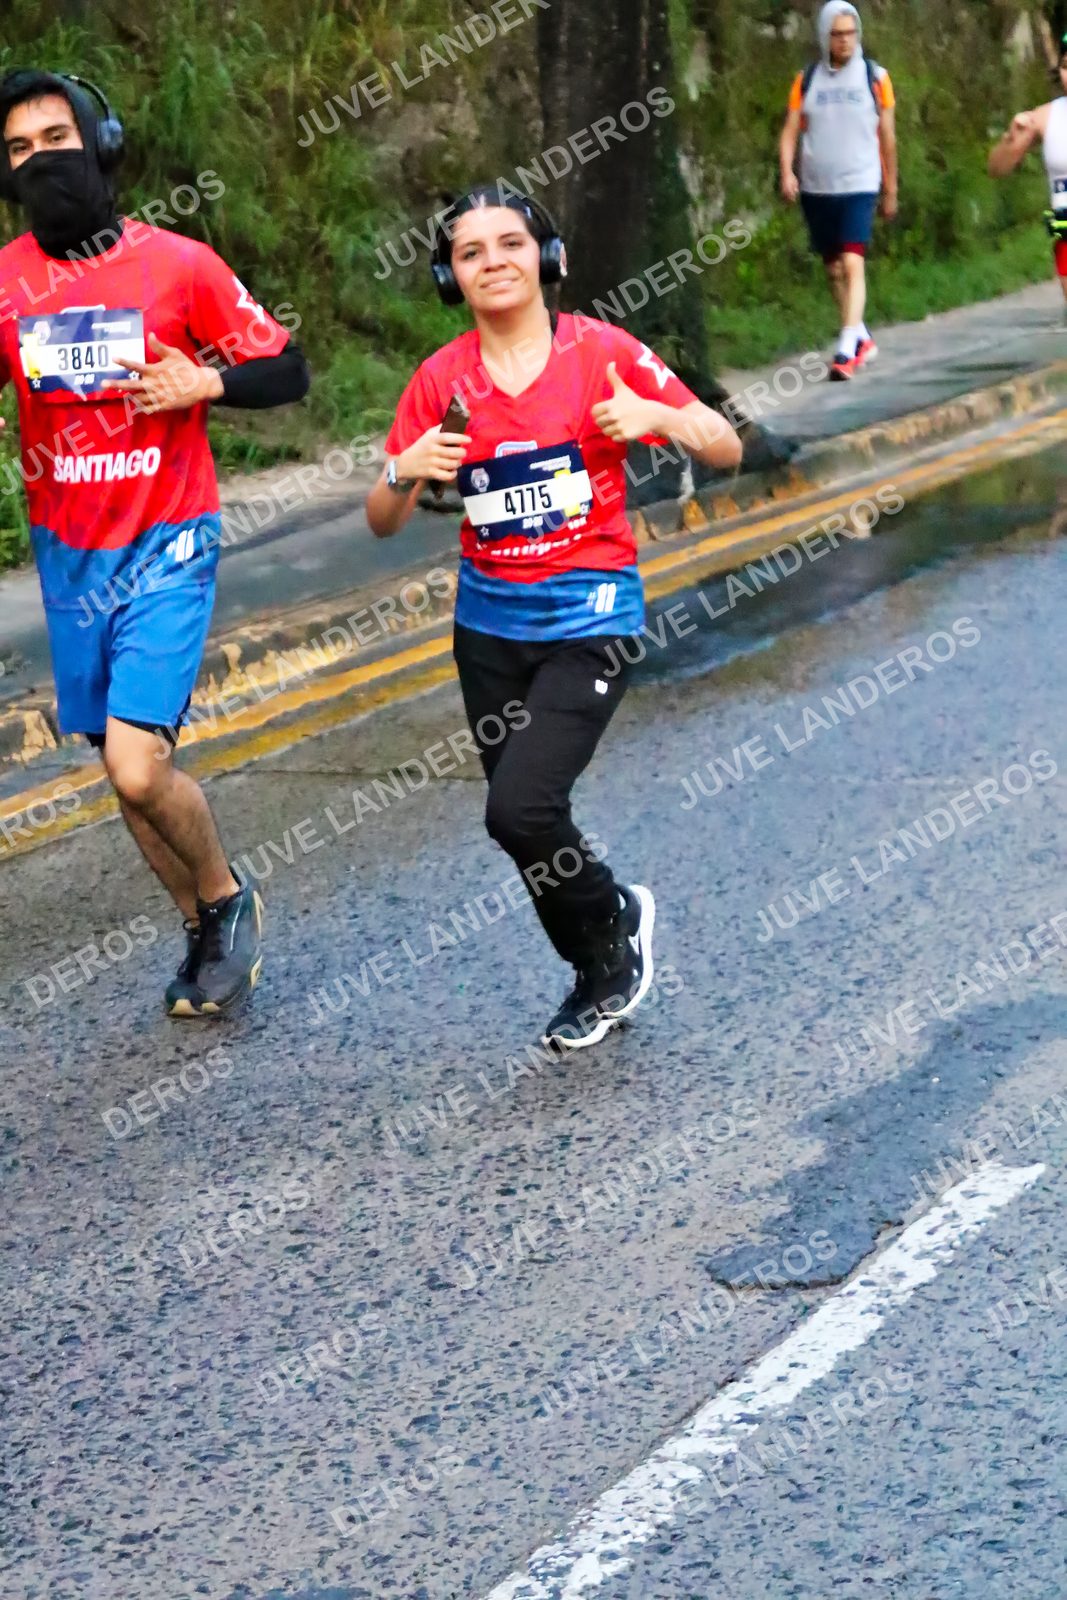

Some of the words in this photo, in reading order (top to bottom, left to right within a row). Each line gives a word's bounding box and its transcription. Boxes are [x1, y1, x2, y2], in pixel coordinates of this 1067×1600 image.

[57, 344, 109, 371] 3840
[53, 446, 161, 484] SANTIAGO
[504, 484, 552, 515] 4775
